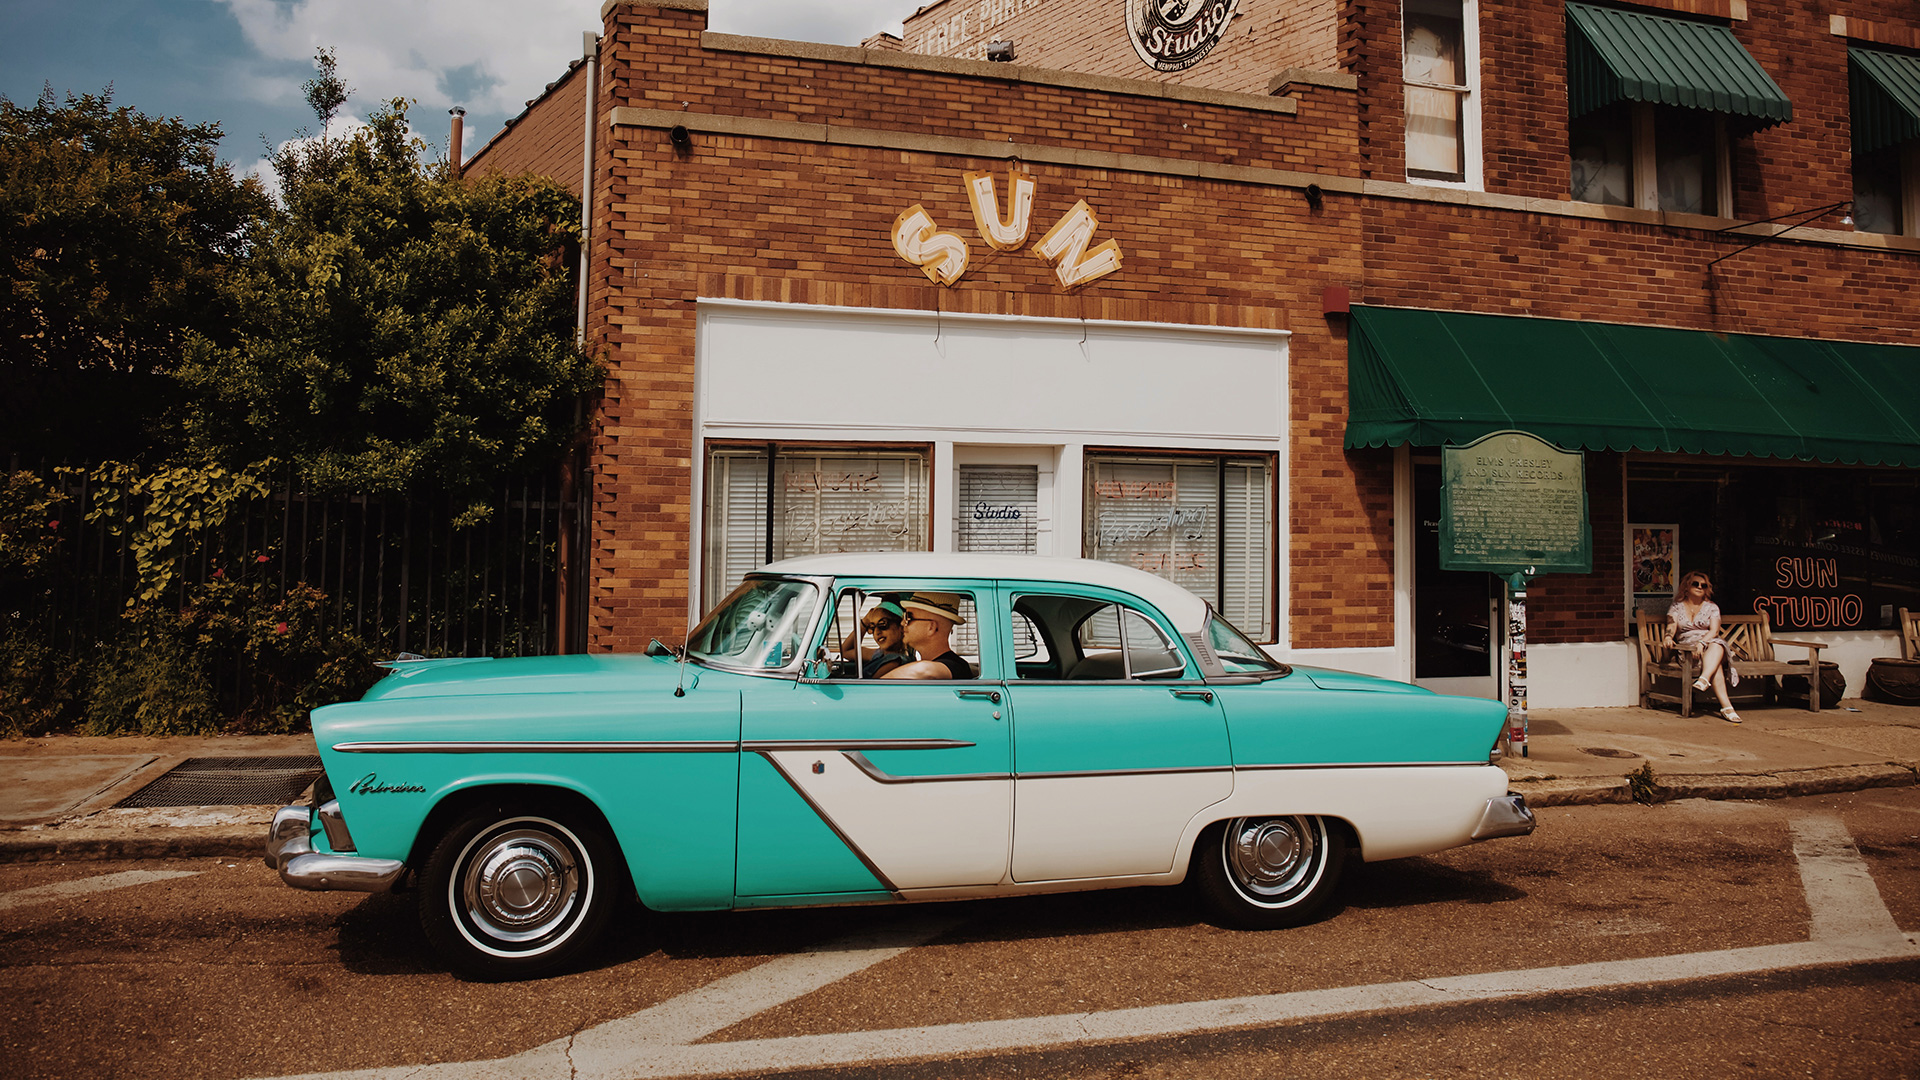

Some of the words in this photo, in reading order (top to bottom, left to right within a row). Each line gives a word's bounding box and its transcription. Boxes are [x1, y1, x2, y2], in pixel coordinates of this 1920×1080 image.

[1146, 2, 1226, 57] Studio
[1156, 61, 1184, 71] MEMPHIS
[1184, 40, 1216, 68] TENNESSEE
[891, 169, 1125, 293] SUN
[1466, 468, 1487, 478] AND
[1491, 469, 1512, 479] SUN
[1516, 470, 1564, 481] RECORDS
[1476, 456, 1504, 467] ELVIS
[1509, 458, 1553, 469] PRESLEY
[1094, 480, 1177, 498] MEMPHIS
[973, 501, 1022, 520] Studio
[1097, 504, 1208, 549] Recording
[1775, 556, 1838, 589] SUN
[1753, 593, 1864, 628] STUDIO
